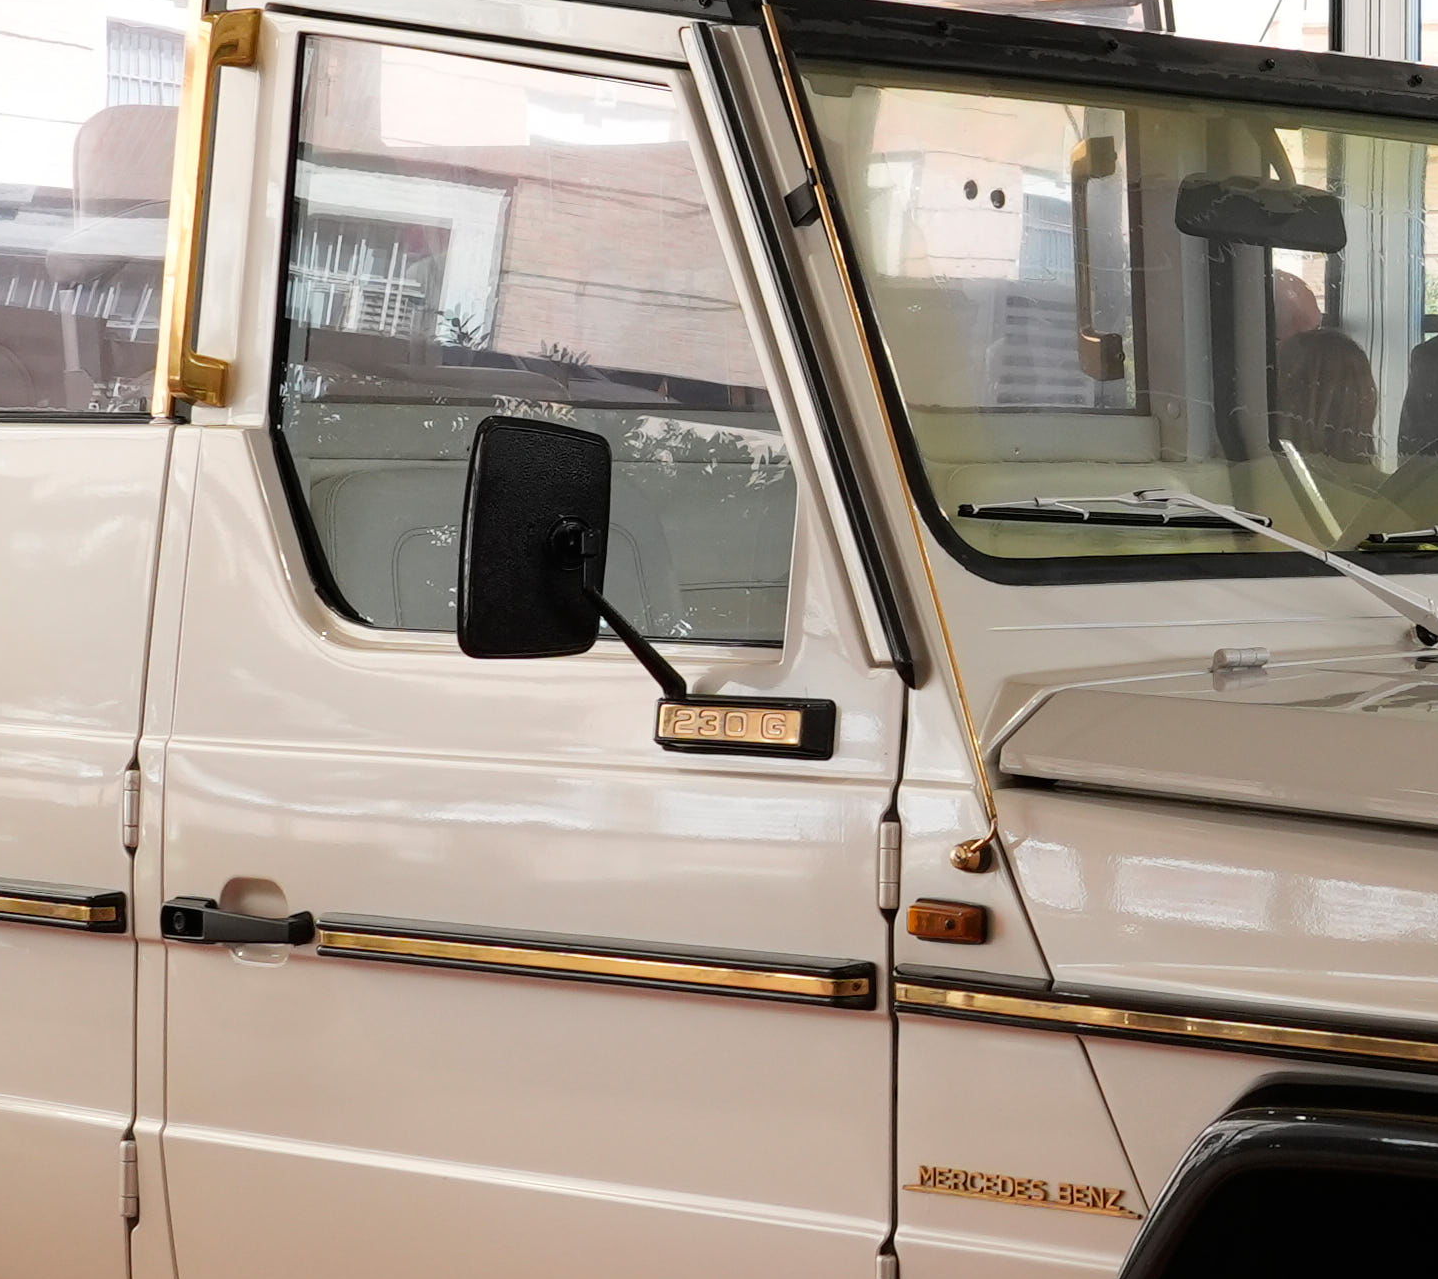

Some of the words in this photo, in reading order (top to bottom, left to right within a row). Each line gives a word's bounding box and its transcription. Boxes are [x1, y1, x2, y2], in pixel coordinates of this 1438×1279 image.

[672, 708, 748, 738] 230
[760, 712, 787, 740] G
[918, 1165, 1048, 1201] MERCEDES
[1057, 1182, 1125, 1210] BENZ
